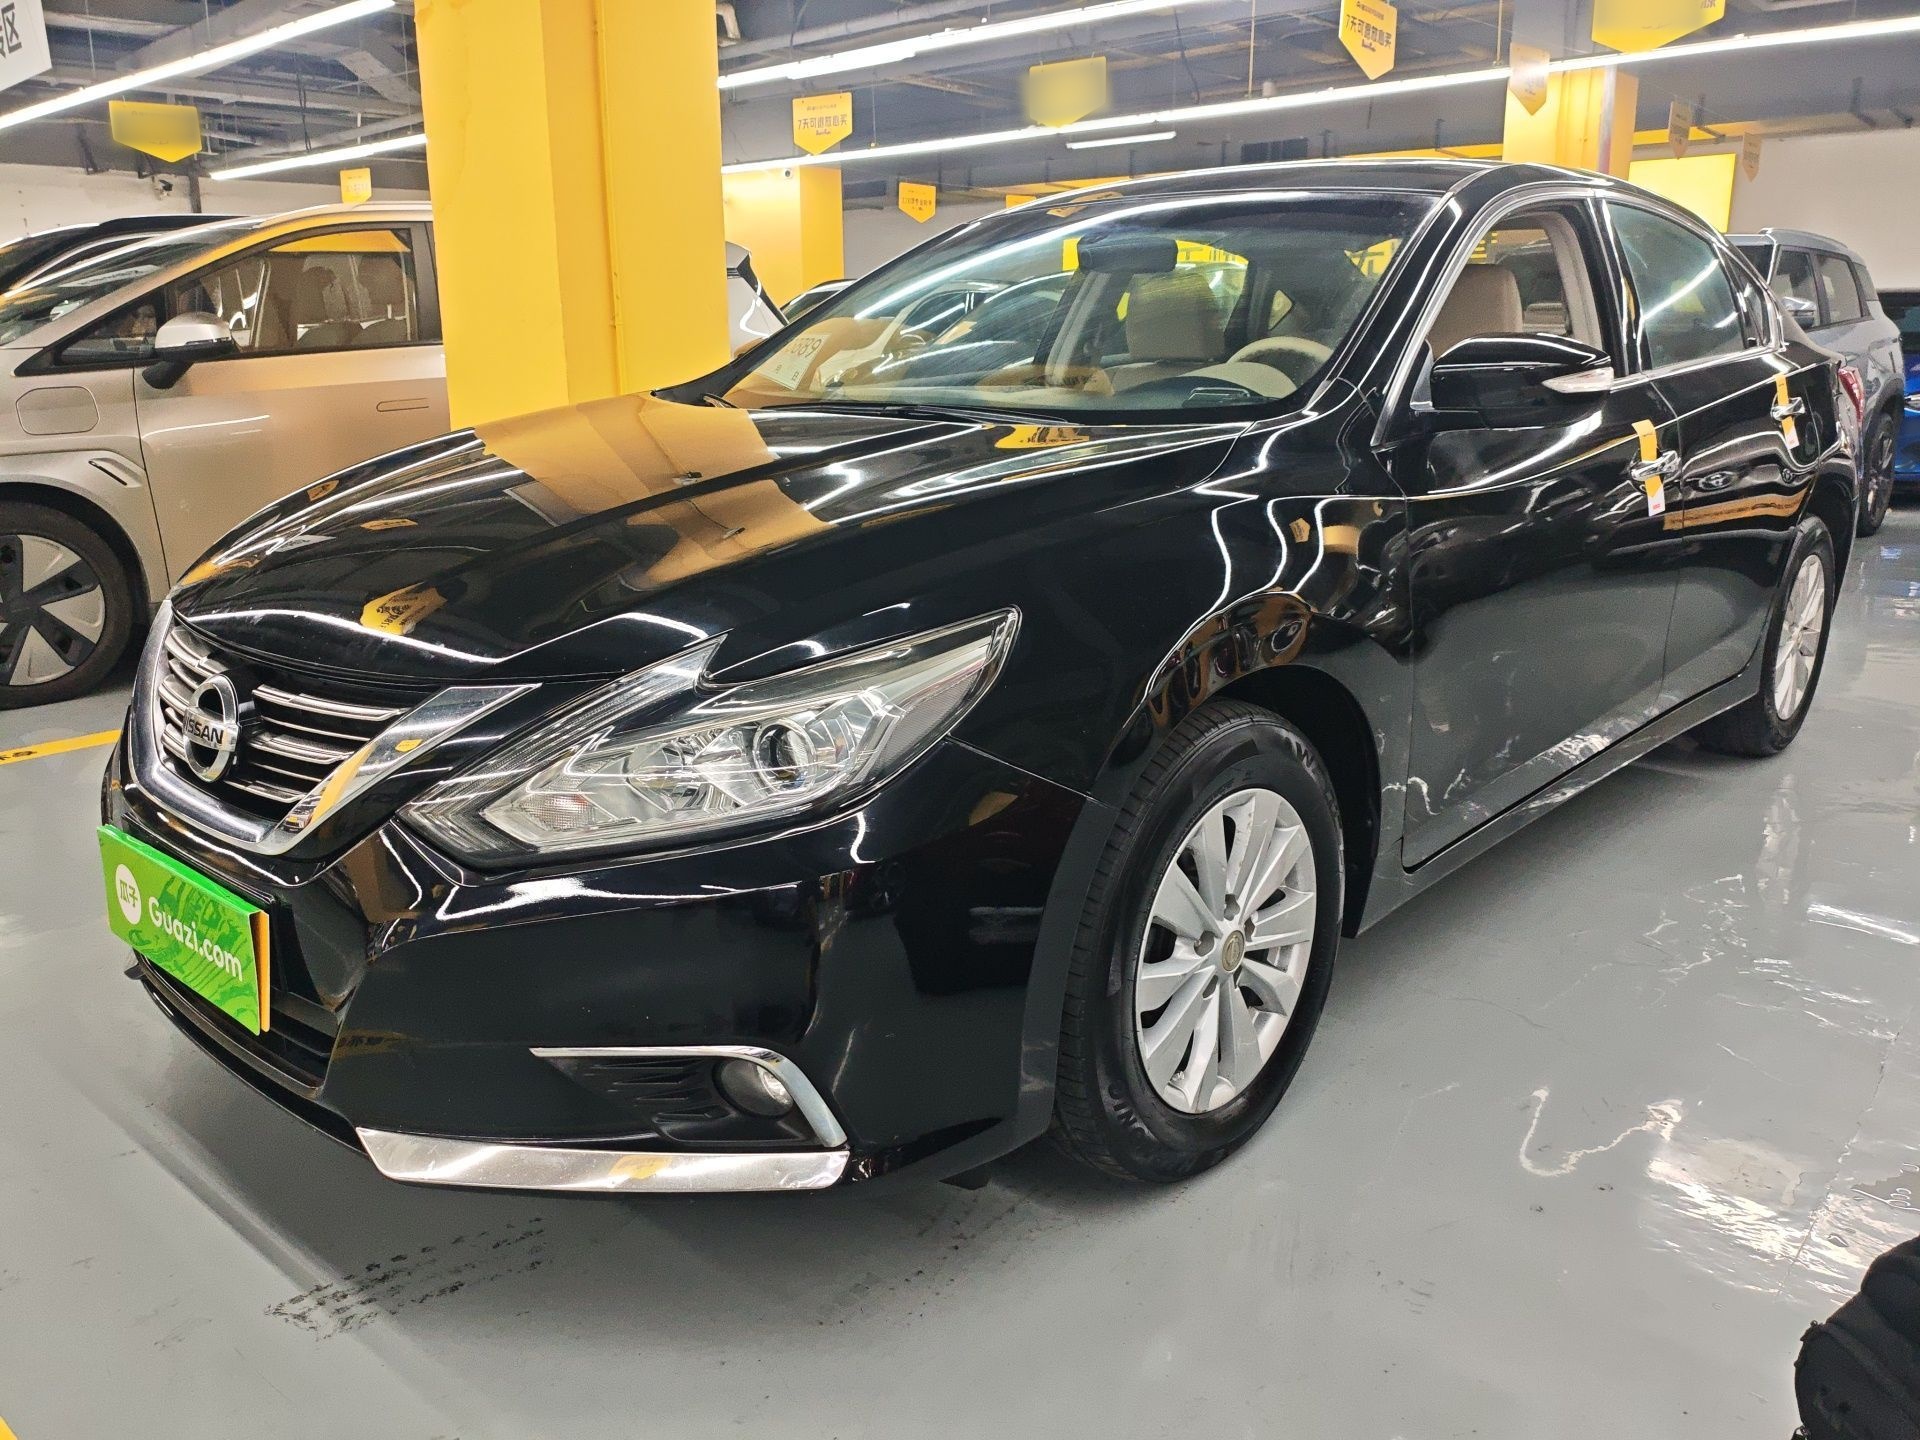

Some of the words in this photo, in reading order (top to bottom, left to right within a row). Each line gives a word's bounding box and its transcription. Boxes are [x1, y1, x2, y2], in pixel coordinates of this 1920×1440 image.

[0, 2, 22, 58] 区
[183, 708, 225, 745] NISSAN
[118, 879, 139, 908] 瓜子
[148, 896, 244, 983] Guazi.com
